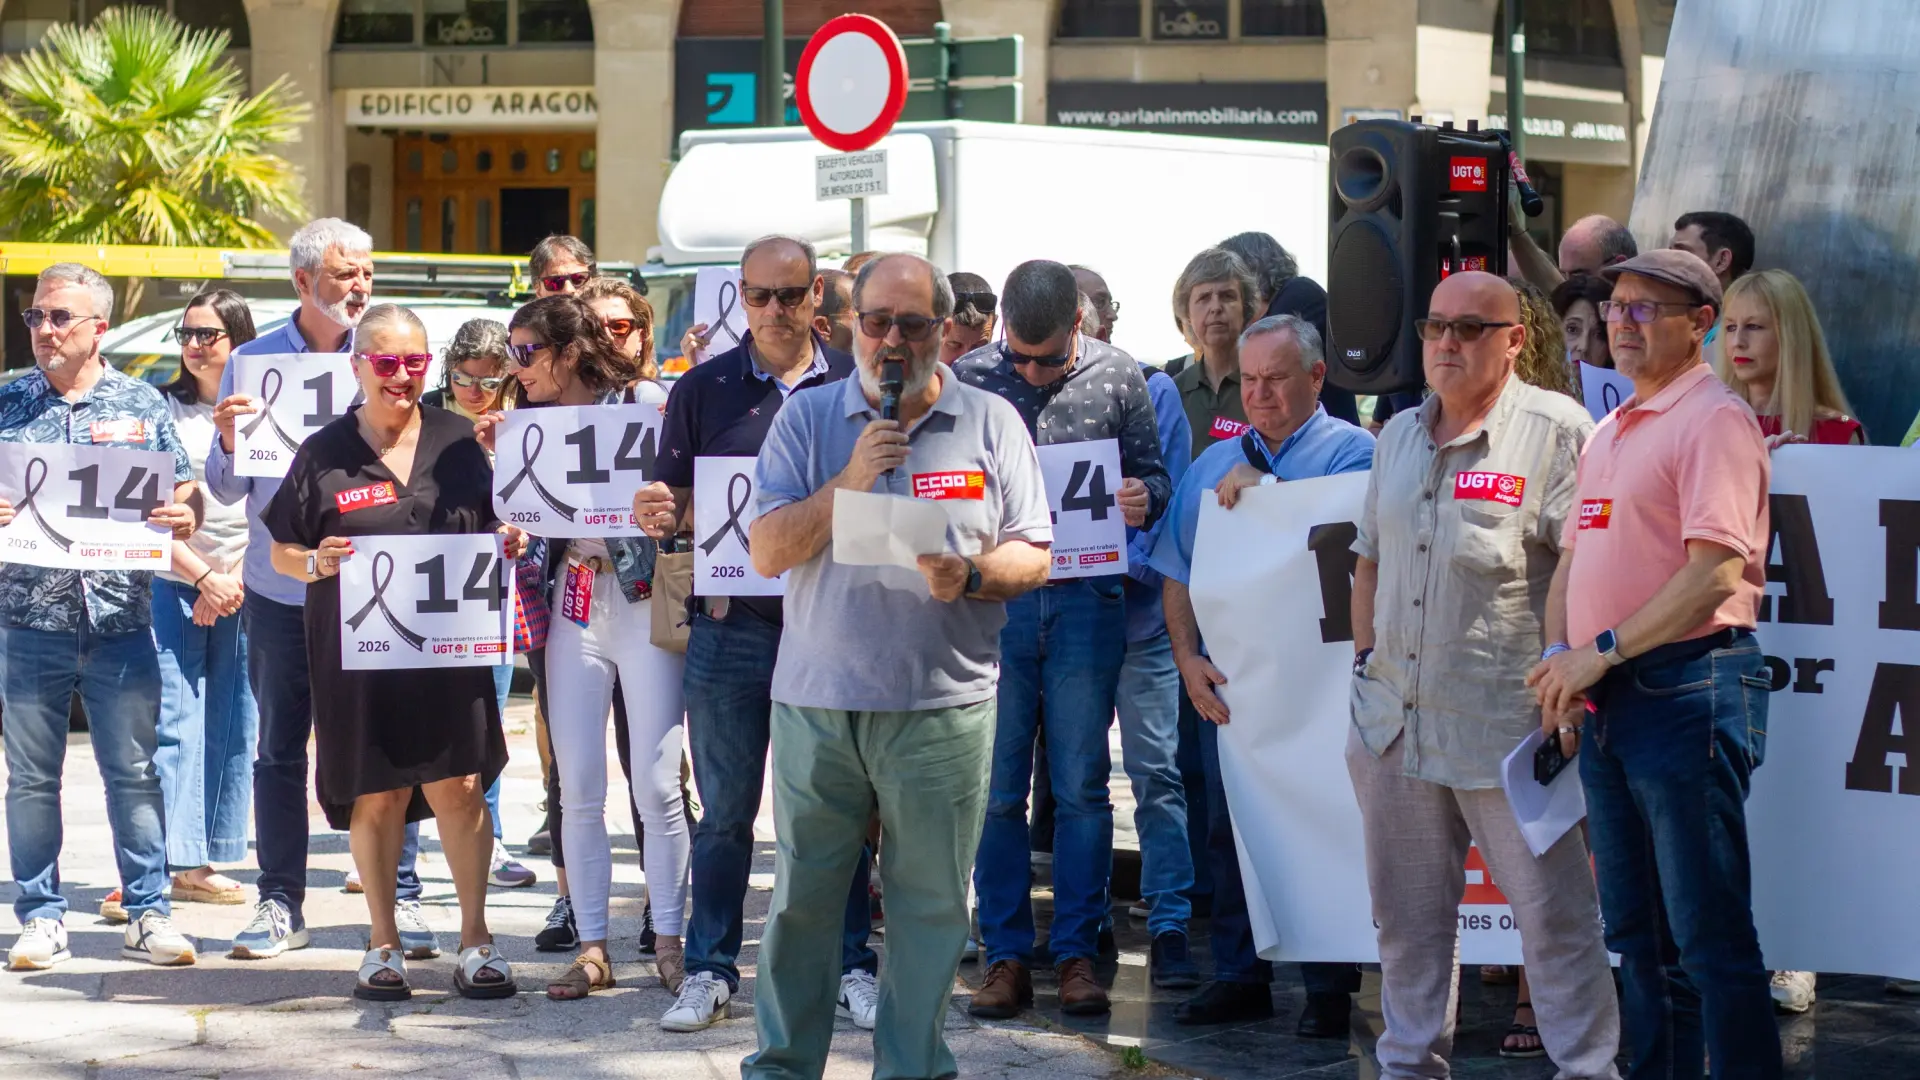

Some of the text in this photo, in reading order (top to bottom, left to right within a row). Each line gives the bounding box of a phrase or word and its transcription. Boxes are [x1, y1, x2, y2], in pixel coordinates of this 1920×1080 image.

[360, 93, 472, 116] EDIFICIO
[1057, 107, 1318, 127] www.garlaninmobiliaria.com
[829, 168, 873, 181] AUTORIZADOS
[1452, 165, 1473, 178] UGT
[1443, 257, 1468, 271] UT
[1214, 417, 1242, 434] UGT
[249, 449, 278, 461] 2026
[565, 422, 658, 485] 14
[915, 474, 966, 491] CCOO
[1458, 473, 1498, 489] UGT
[66, 464, 165, 522] 14
[338, 488, 370, 505] UGT
[918, 489, 946, 499] Aragón
[1050, 460, 1116, 525] 4
[1494, 492, 1520, 504] Aragón
[509, 511, 541, 523] 2026
[584, 514, 607, 525] UGT
[7, 537, 38, 550] 2026
[1054, 546, 1080, 554] muertes
[1096, 543, 1119, 551] trabajo
[80, 548, 102, 557] UGT
[1080, 554, 1107, 563] CCOO
[710, 565, 745, 578] 2026
[415, 552, 509, 614] 14
[563, 585, 575, 617] UGT
[574, 585, 586, 618] UGT
[358, 640, 391, 653] 2026
[432, 644, 454, 654] UGT
